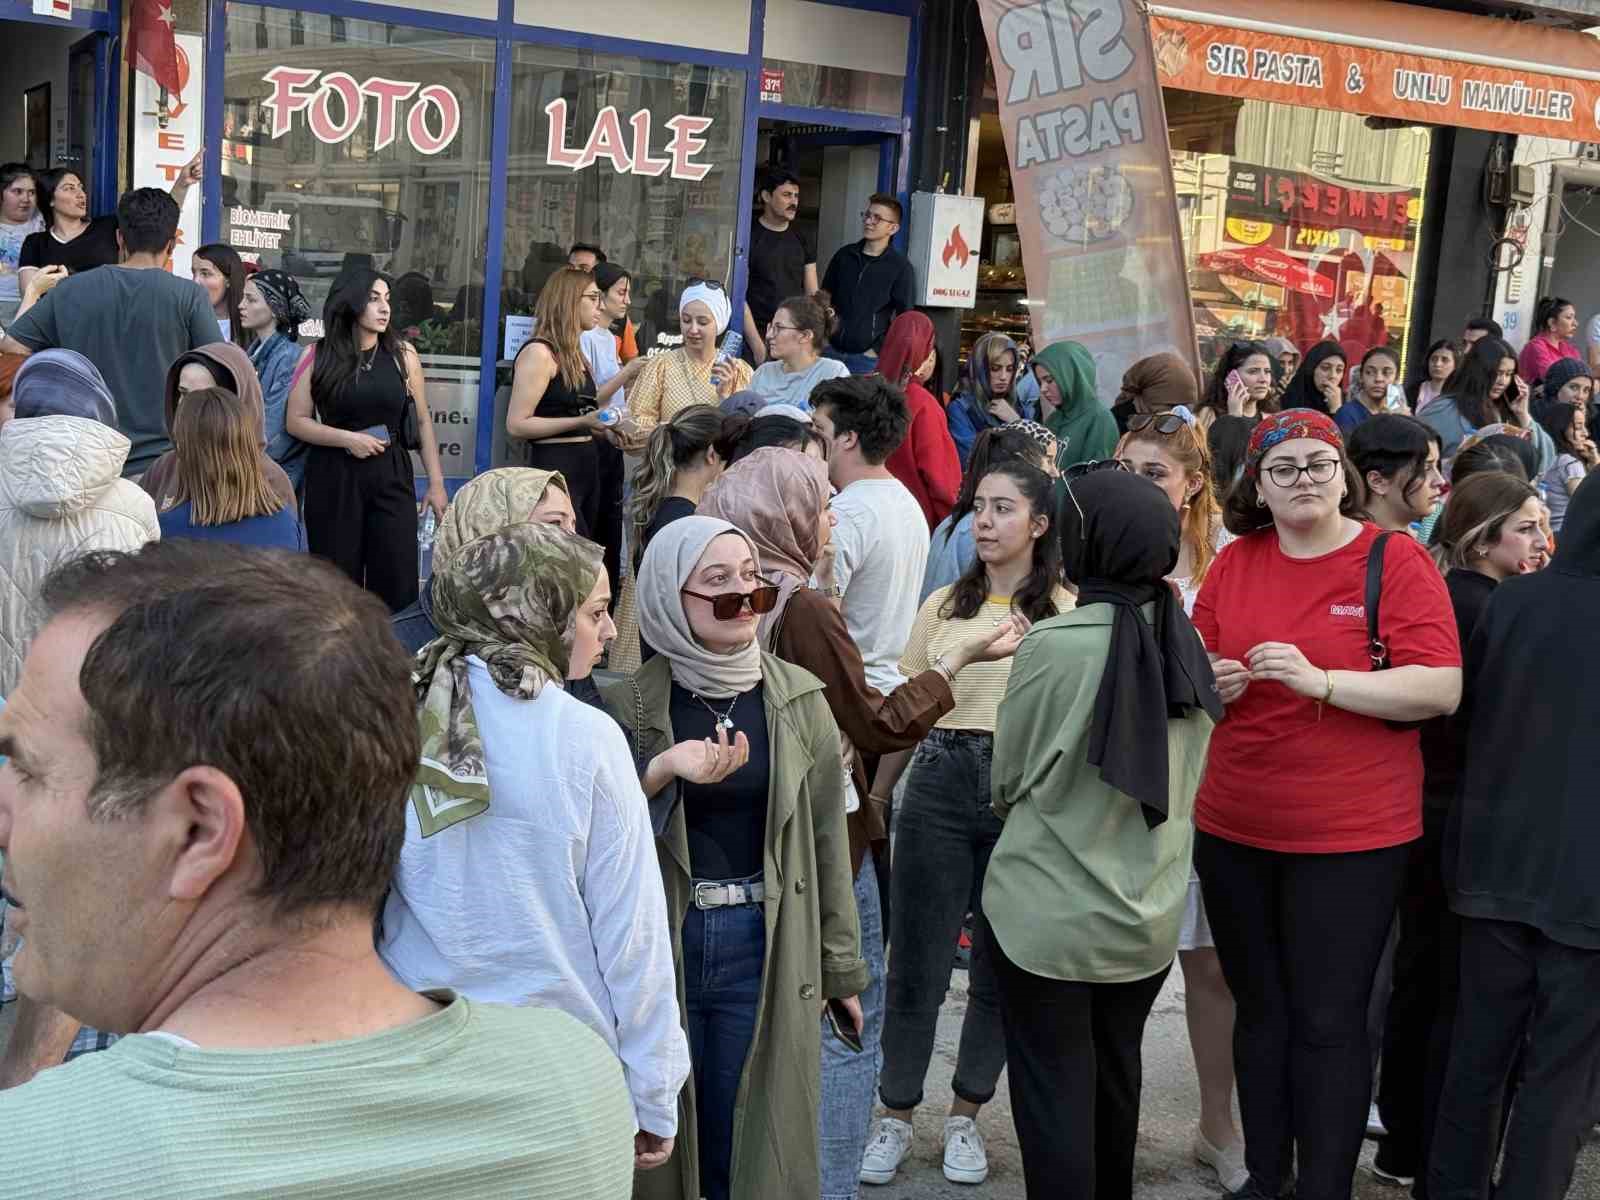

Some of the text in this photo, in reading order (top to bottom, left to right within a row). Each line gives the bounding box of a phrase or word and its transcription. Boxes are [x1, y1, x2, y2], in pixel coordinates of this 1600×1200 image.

[262, 65, 460, 155] FOTO
[1207, 42, 1248, 79] SIR
[1251, 48, 1323, 88] PASTA
[1344, 62, 1365, 93] &
[1393, 69, 1452, 105] UNLU
[1461, 80, 1574, 121] MAMÜLLER
[545, 97, 713, 181] LALE
[230, 205, 291, 231] BİOMETRİK
[230, 228, 282, 249] EHLİYET
